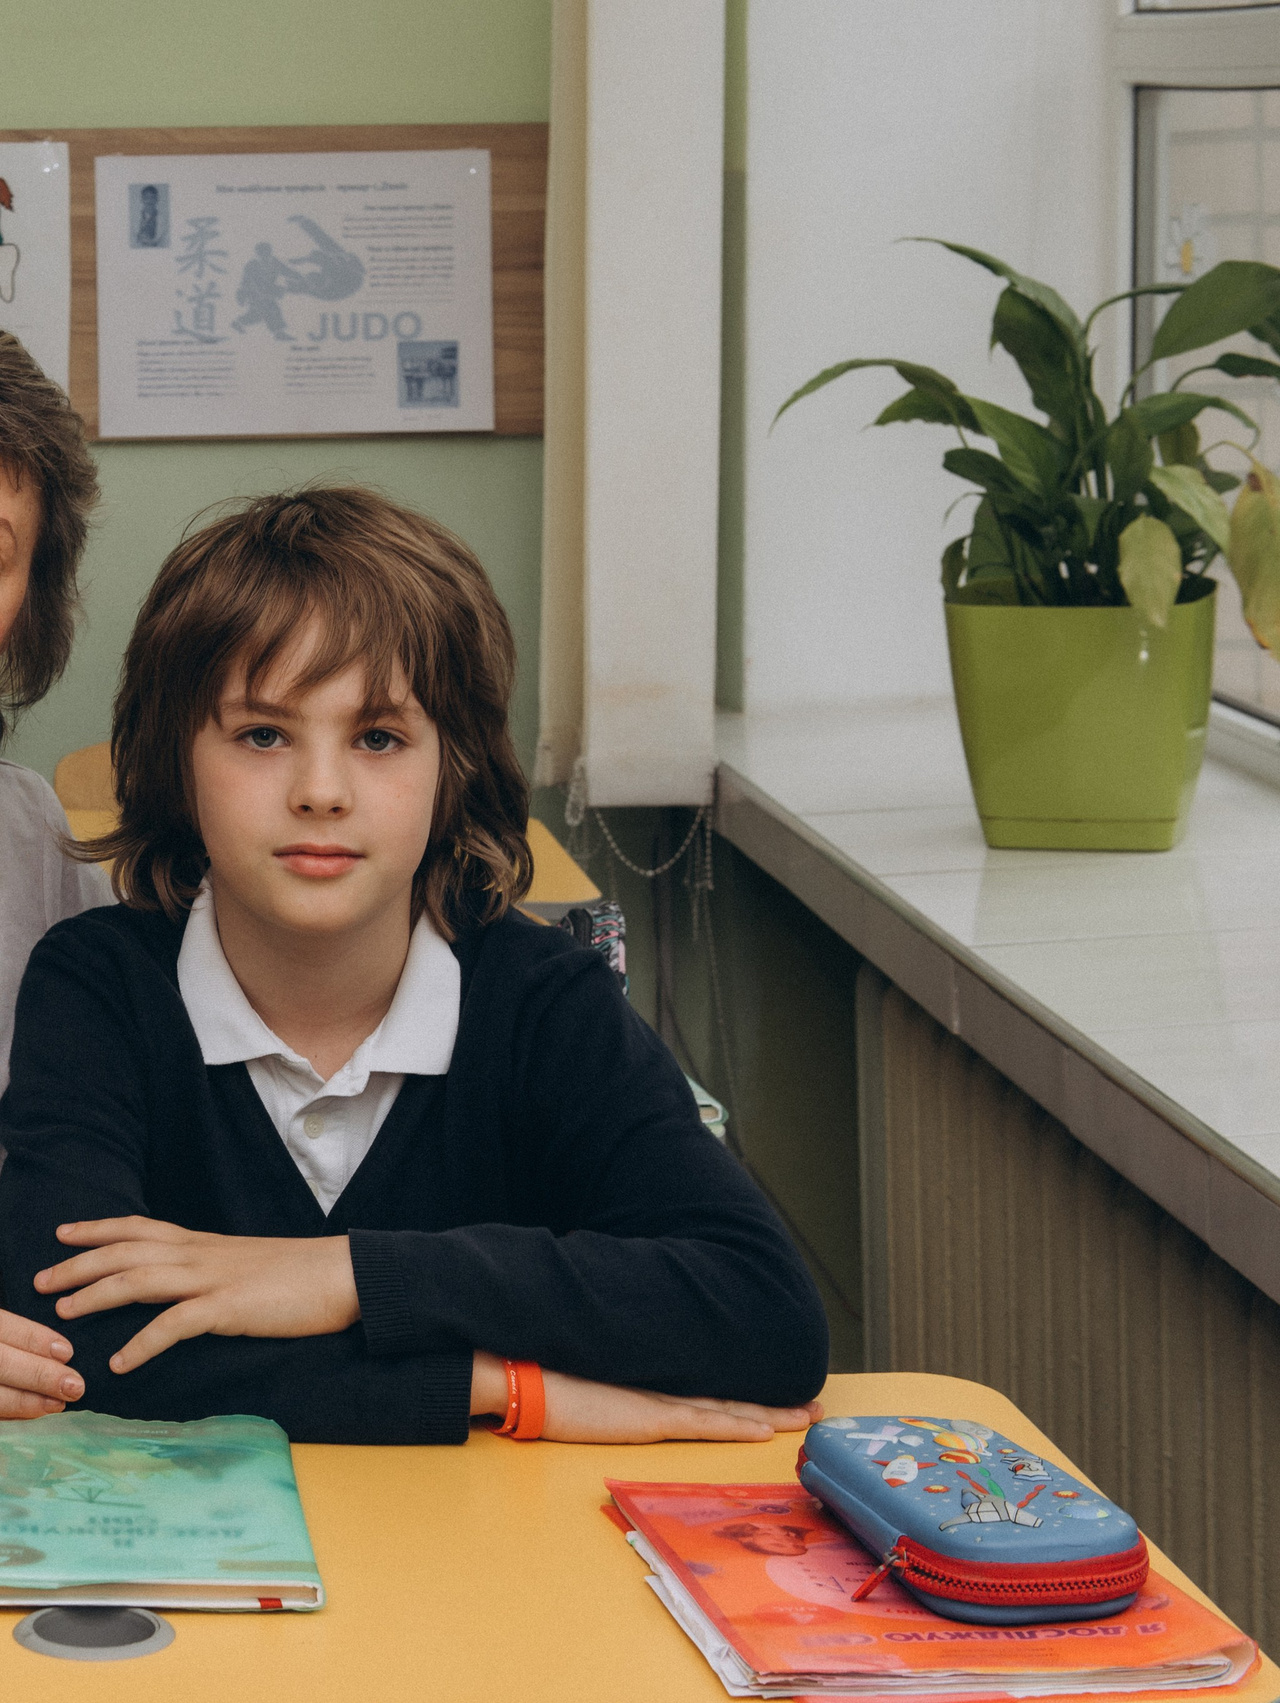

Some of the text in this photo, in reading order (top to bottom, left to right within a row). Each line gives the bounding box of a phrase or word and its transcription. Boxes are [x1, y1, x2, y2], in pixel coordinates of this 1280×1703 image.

[308, 311, 422, 342] JUDO
[883, 1625, 1126, 1643] ДОСЛІДЖУЮ
[1137, 1622, 1164, 1635] Я
